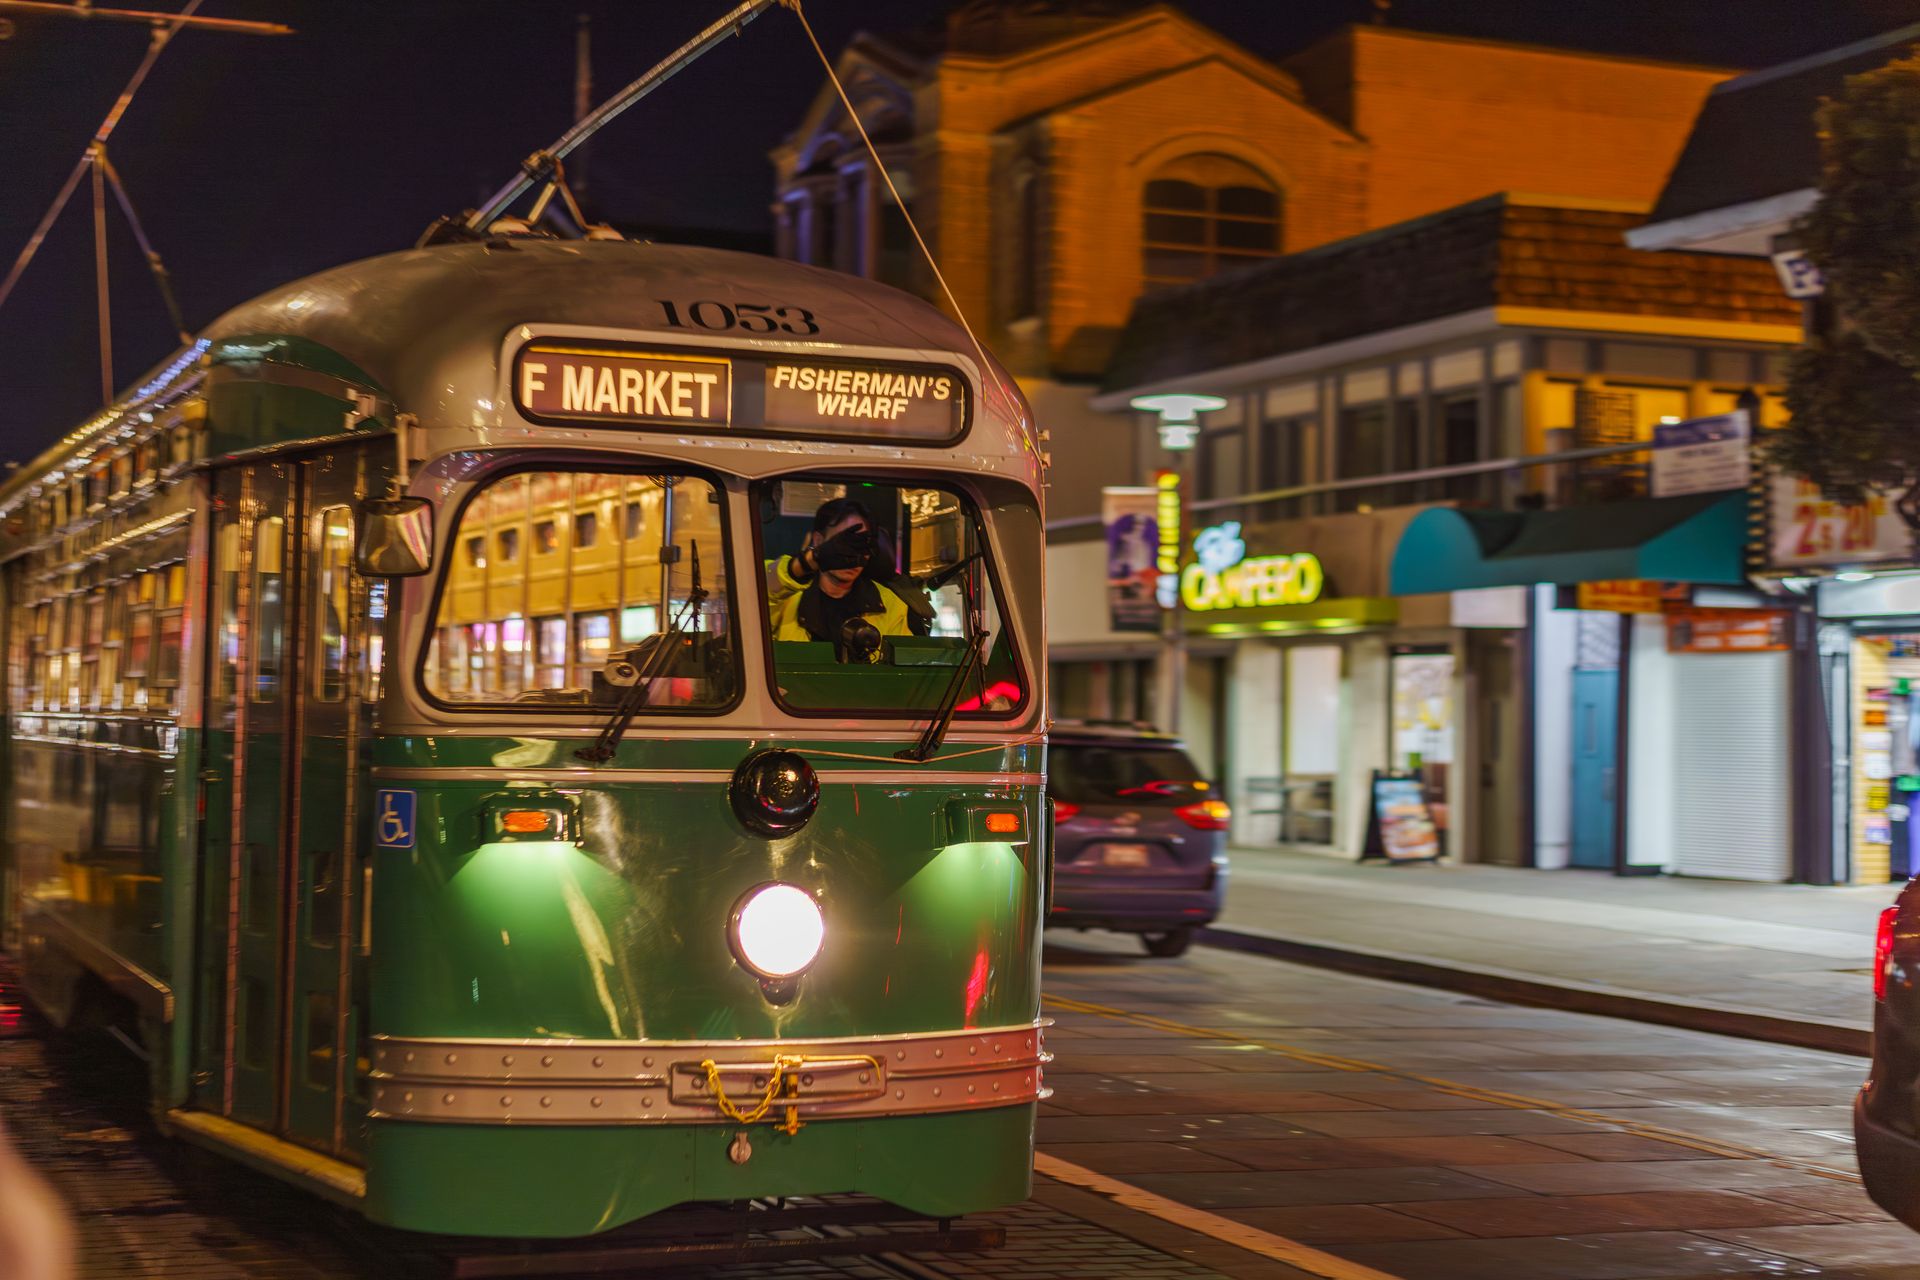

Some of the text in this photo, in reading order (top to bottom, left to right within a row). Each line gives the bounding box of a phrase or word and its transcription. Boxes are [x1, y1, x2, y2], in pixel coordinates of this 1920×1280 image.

[654, 299, 820, 336] 1053
[522, 361, 718, 418] F MARKET
[773, 365, 951, 401] FISHERMAN'S
[816, 392, 909, 420] WHARF
